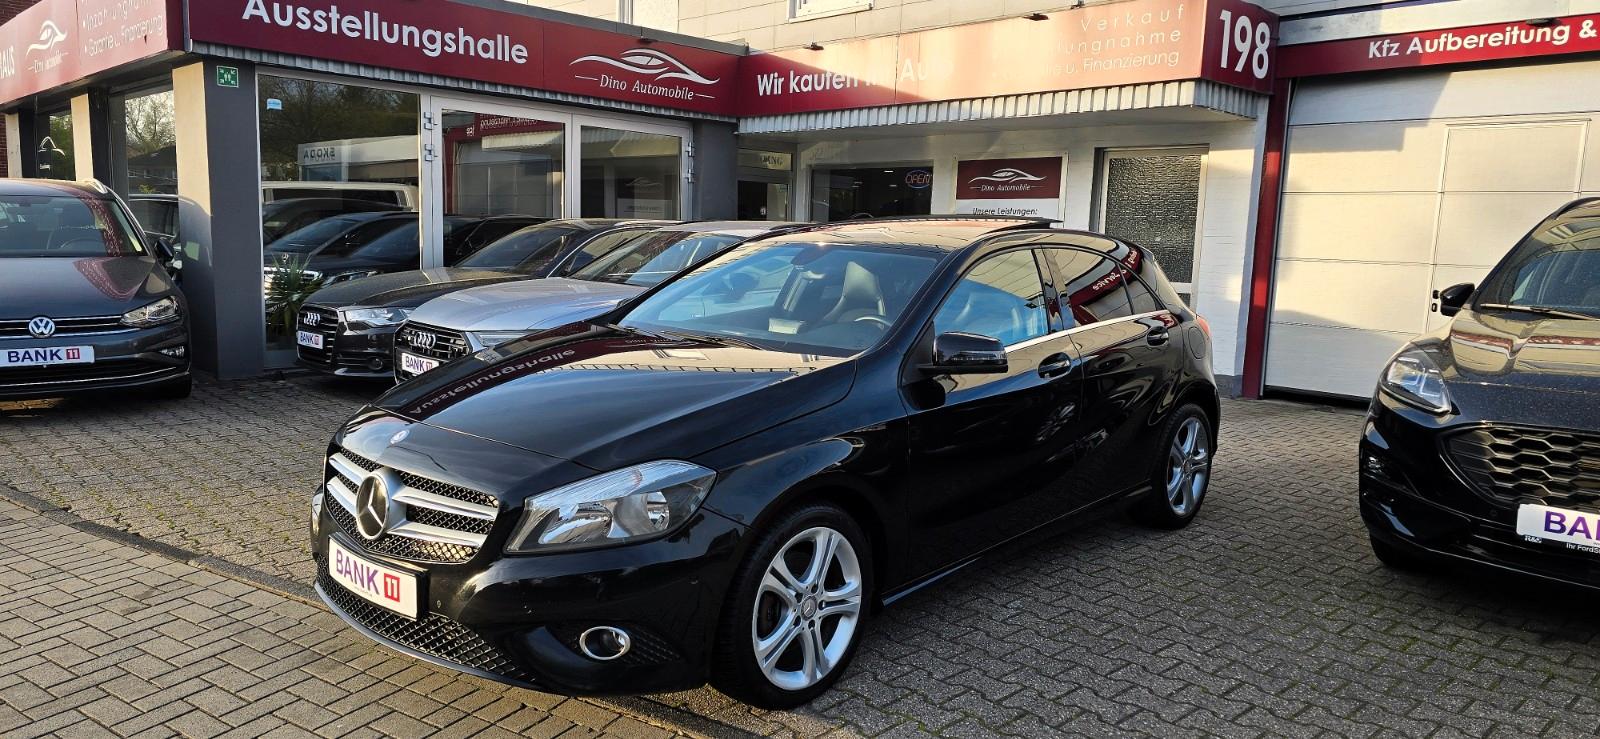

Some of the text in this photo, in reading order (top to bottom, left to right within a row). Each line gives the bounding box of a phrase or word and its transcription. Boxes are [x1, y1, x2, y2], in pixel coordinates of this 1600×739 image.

[1081, 4, 1184, 32] Verkauf
[242, 0, 528, 65] Ausstellungshalle
[1219, 9, 1271, 79] 198
[1369, 20, 1597, 59] Kfz Aufbereitung &
[1083, 51, 1180, 73] Finanzierung
[599, 73, 694, 101] Dino Automobile
[757, 72, 785, 97] Wir
[789, 70, 859, 94] kaufen
[981, 183, 1031, 192] Dino Automobile
[972, 207, 1038, 216] Unsere Leistungen:
[299, 332, 314, 345] BANK
[7, 348, 80, 363] BANK 11
[405, 355, 426, 372] BANK
[1544, 510, 1600, 541] BA
[1566, 542, 1576, 550] Ihr
[335, 548, 399, 601] BANK 11
